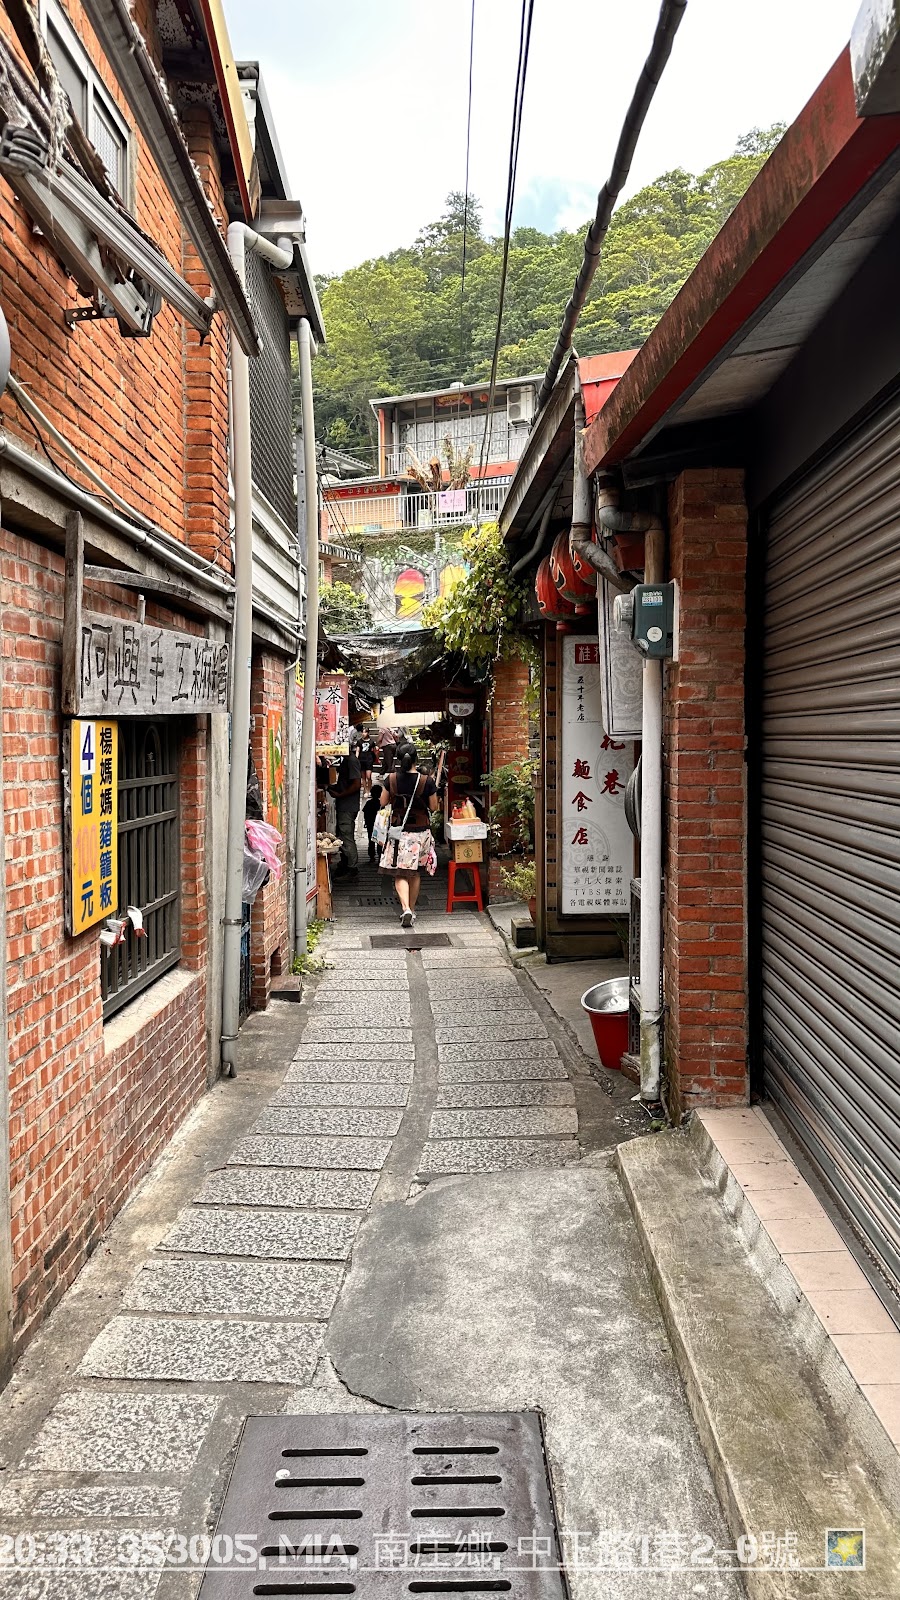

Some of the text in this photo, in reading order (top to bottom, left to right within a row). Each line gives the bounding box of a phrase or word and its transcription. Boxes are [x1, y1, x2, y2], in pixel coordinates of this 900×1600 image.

[100, 727, 112, 911] 楊媽媽豬籠粄
[571, 759, 593, 845] 麵食店
